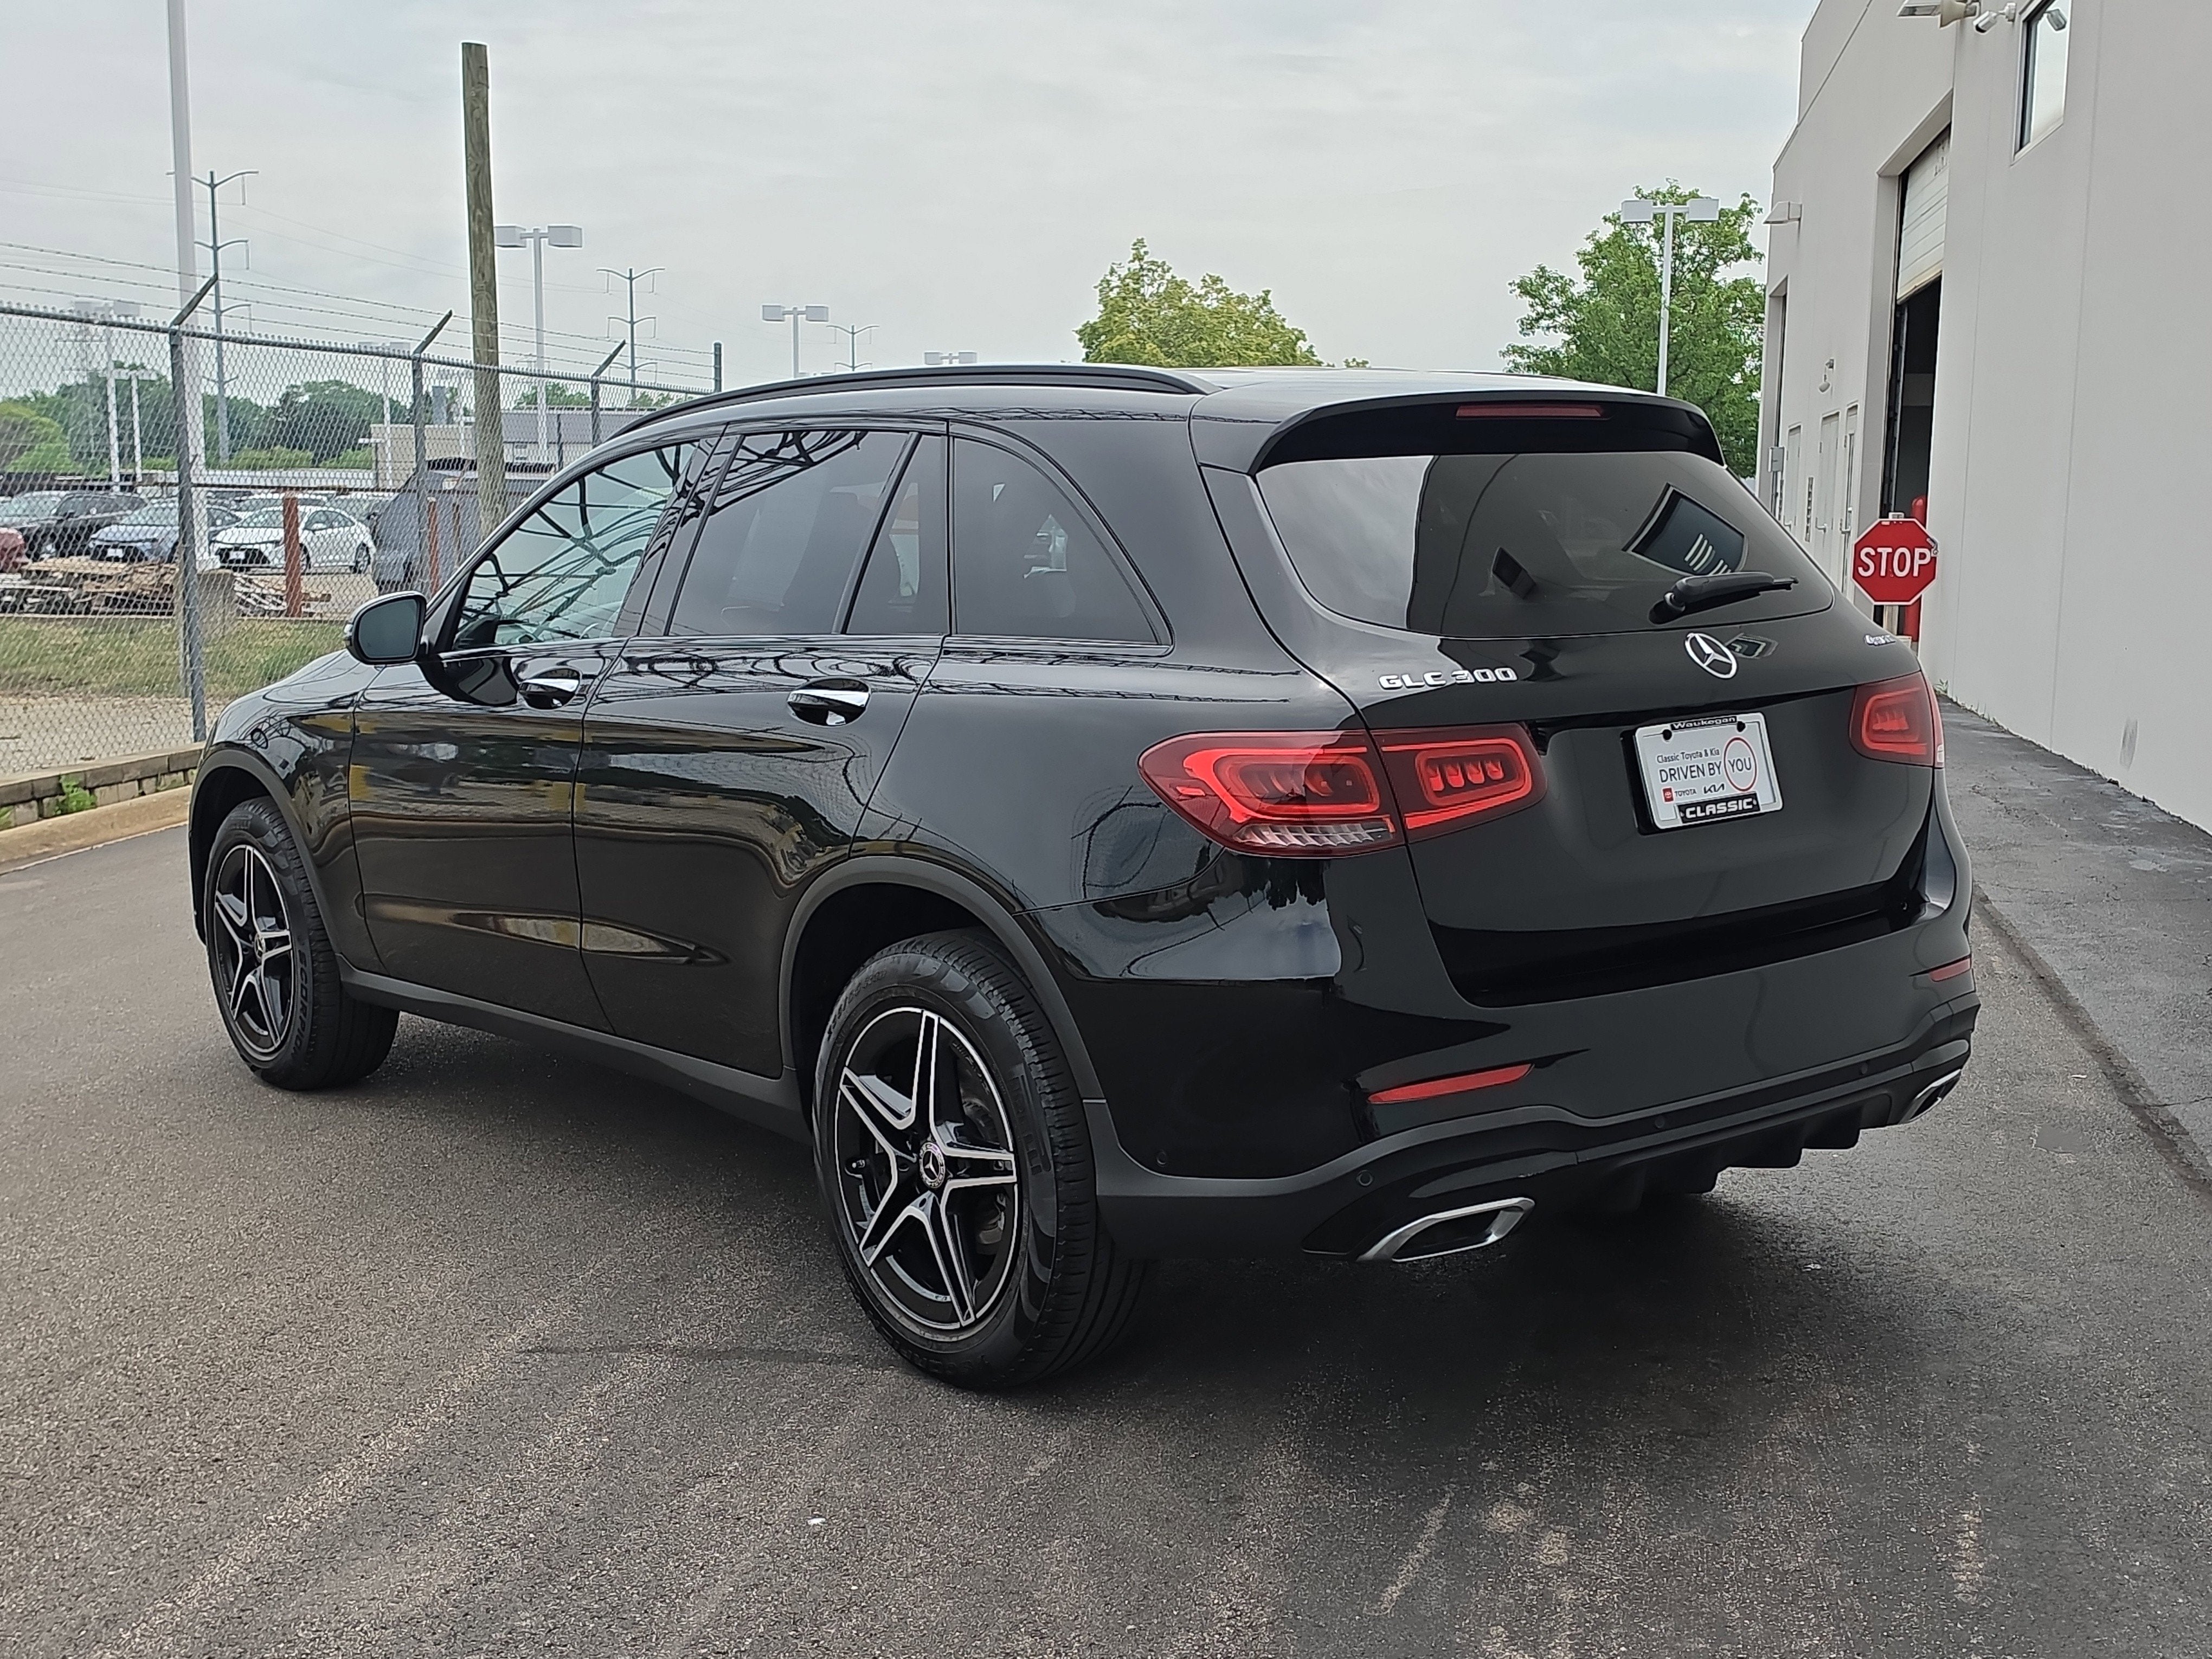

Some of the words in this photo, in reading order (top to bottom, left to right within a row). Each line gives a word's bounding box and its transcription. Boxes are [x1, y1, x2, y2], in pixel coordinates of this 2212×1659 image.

[1857, 546, 1931, 577] STOP
[1379, 671, 1446, 689] GLC
[1451, 667, 1517, 684] 300
[1657, 753, 1680, 764] Classic
[1681, 751, 1702, 760] Toyota
[1703, 749, 1709, 757] &
[1710, 748, 1720, 756] Kia
[1660, 764, 1705, 783] DRIVEN
[1707, 761, 1722, 775] BY
[1727, 757, 1752, 773] YOU
[1674, 788, 1697, 797] TOYOTA
[1686, 798, 1753, 819] CLASSIC
